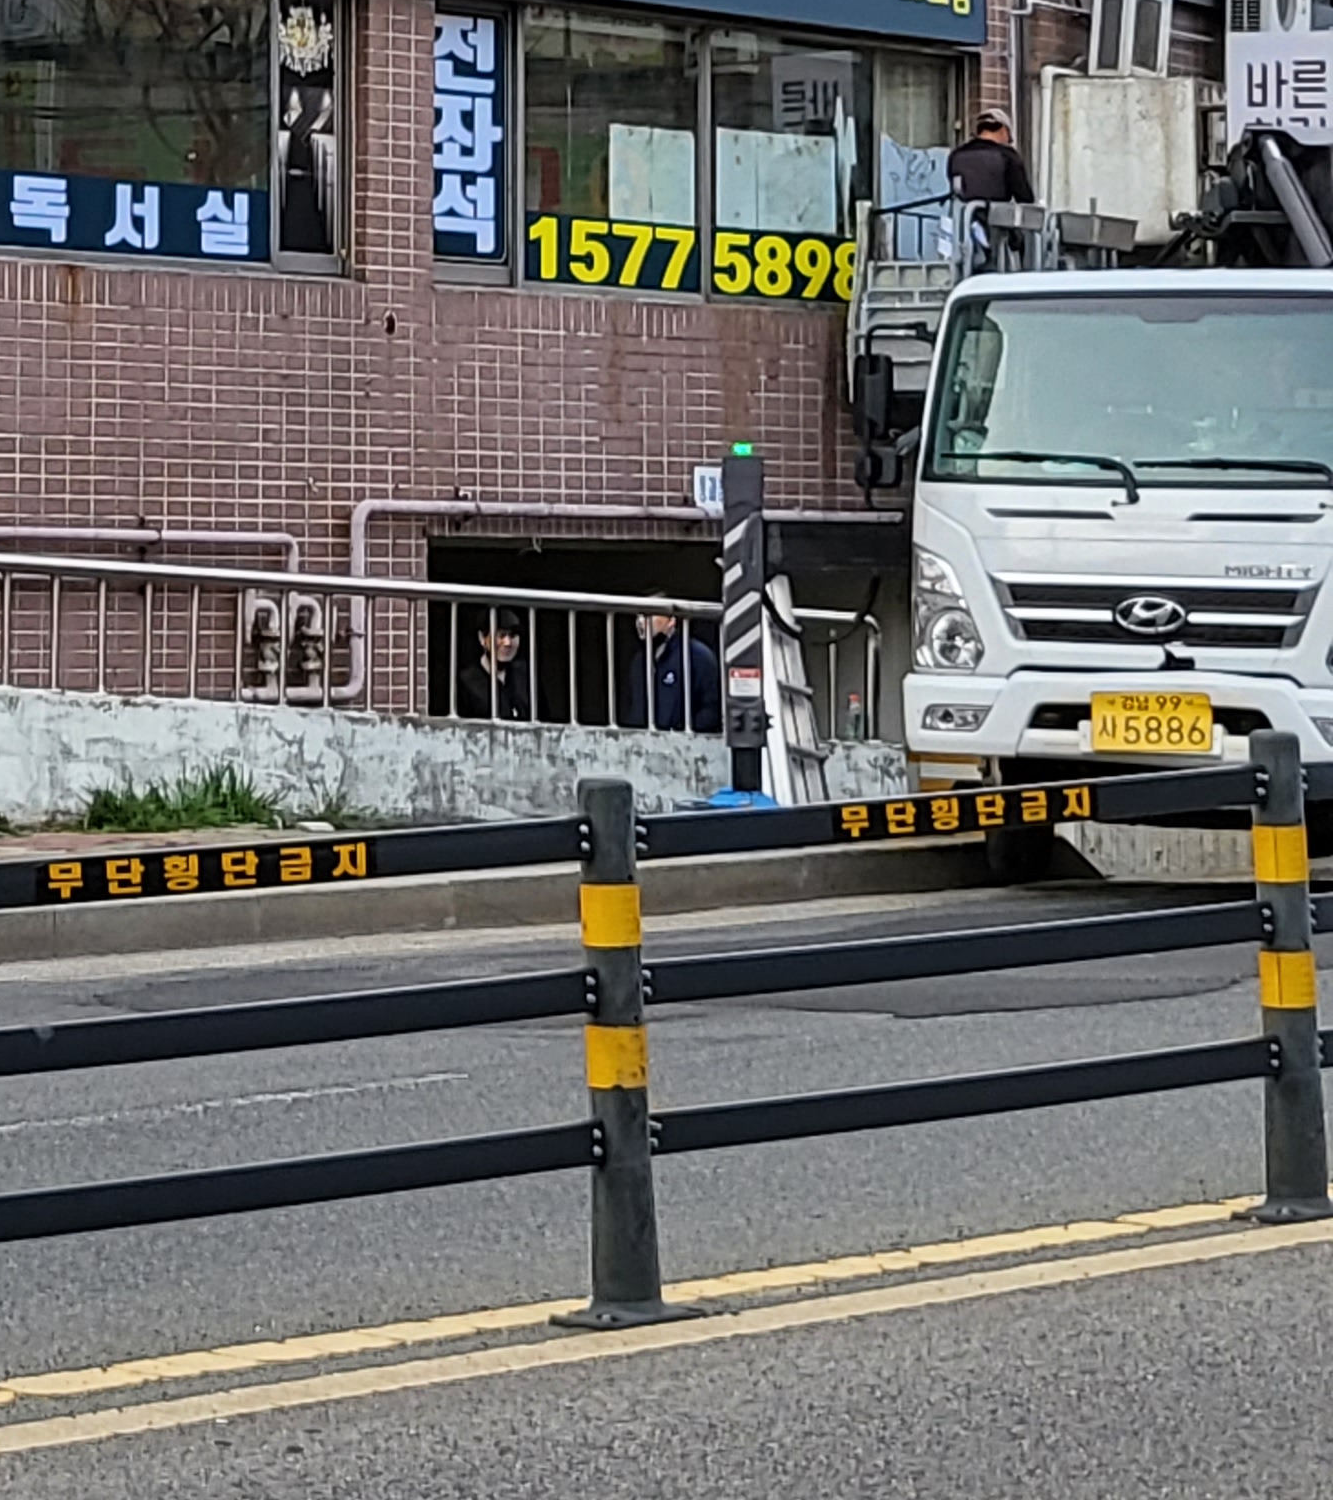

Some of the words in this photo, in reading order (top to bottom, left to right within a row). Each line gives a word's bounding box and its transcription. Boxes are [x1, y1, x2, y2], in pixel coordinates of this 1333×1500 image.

[1246, 60, 1327, 109] 바른
[433, 14, 503, 254] 전좌석
[9, 175, 250, 255] 독서실
[529, 216, 695, 289] 1577
[714, 233, 857, 301] 5898
[1225, 565, 1314, 578] MIGHTY
[1155, 696, 1182, 711] 99
